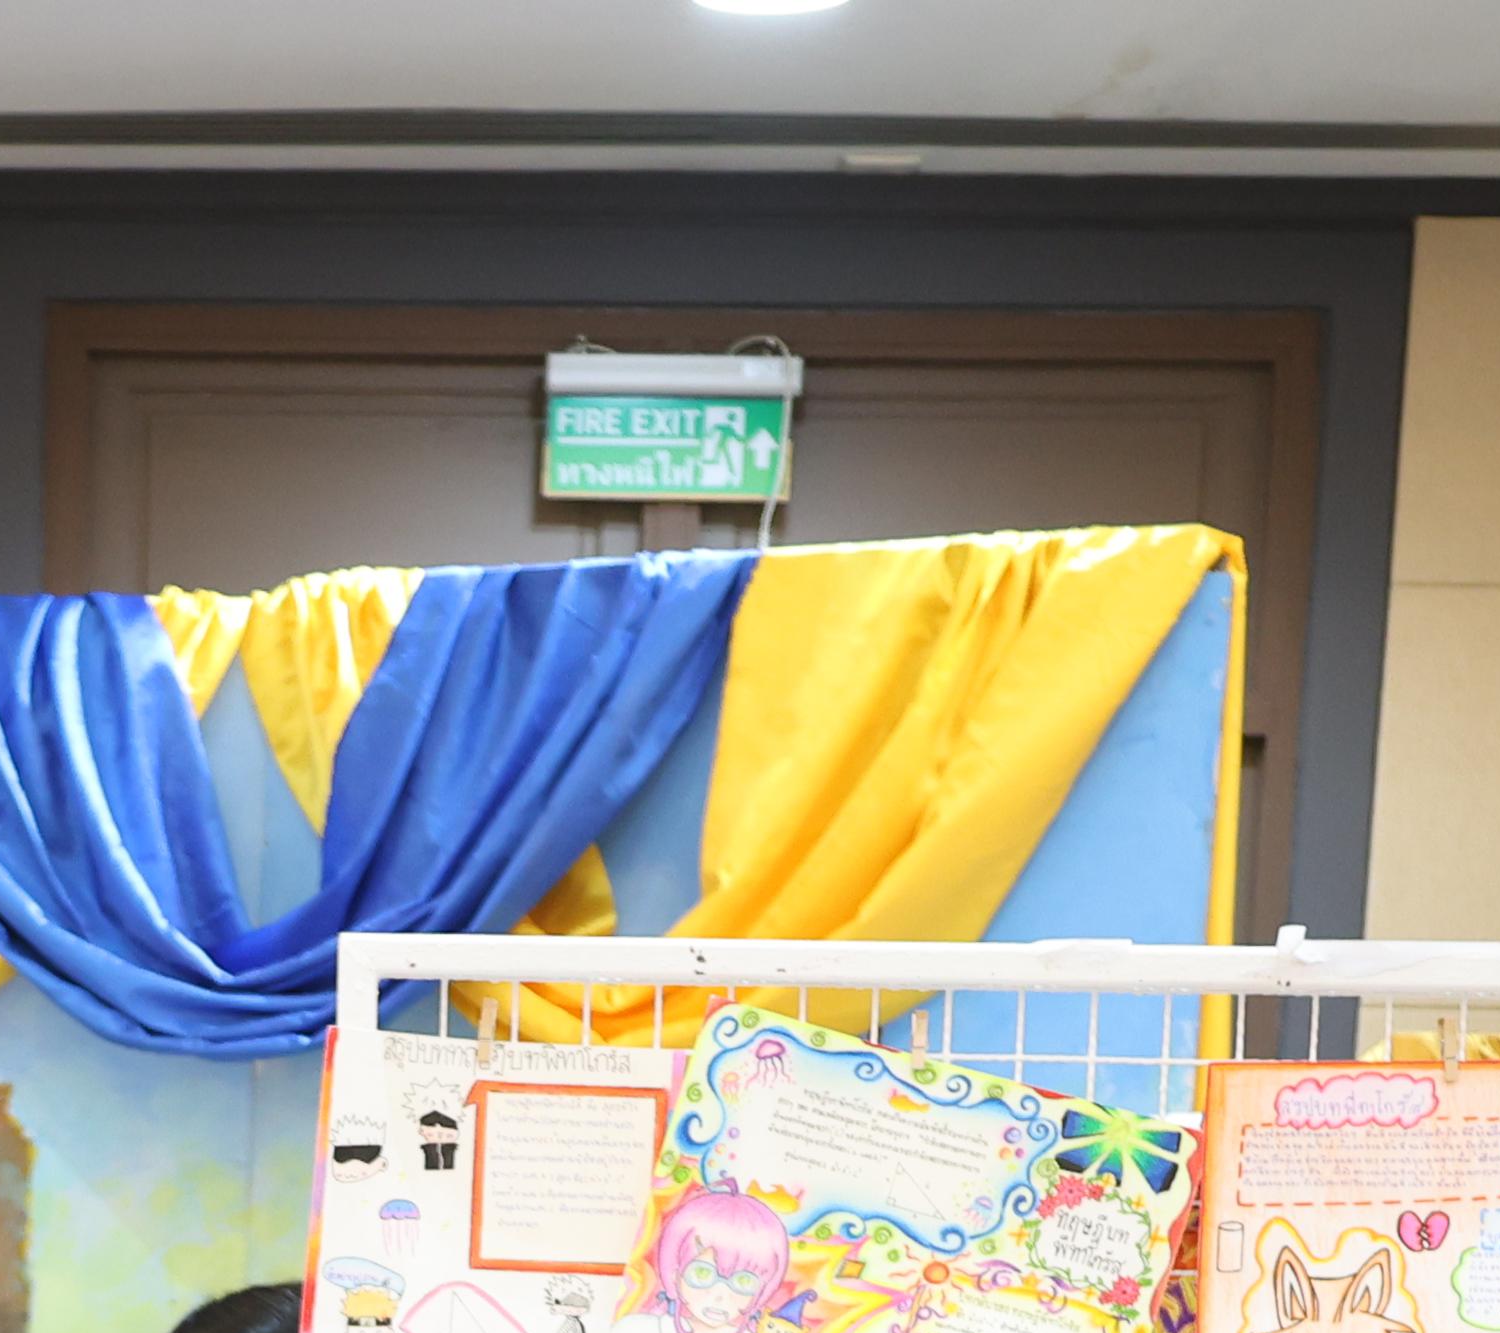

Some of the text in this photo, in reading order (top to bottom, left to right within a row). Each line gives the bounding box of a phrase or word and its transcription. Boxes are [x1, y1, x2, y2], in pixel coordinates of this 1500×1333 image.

[557, 407, 701, 435] FIRE EXIT
[558, 450, 698, 486] ทางหนีไฟ
